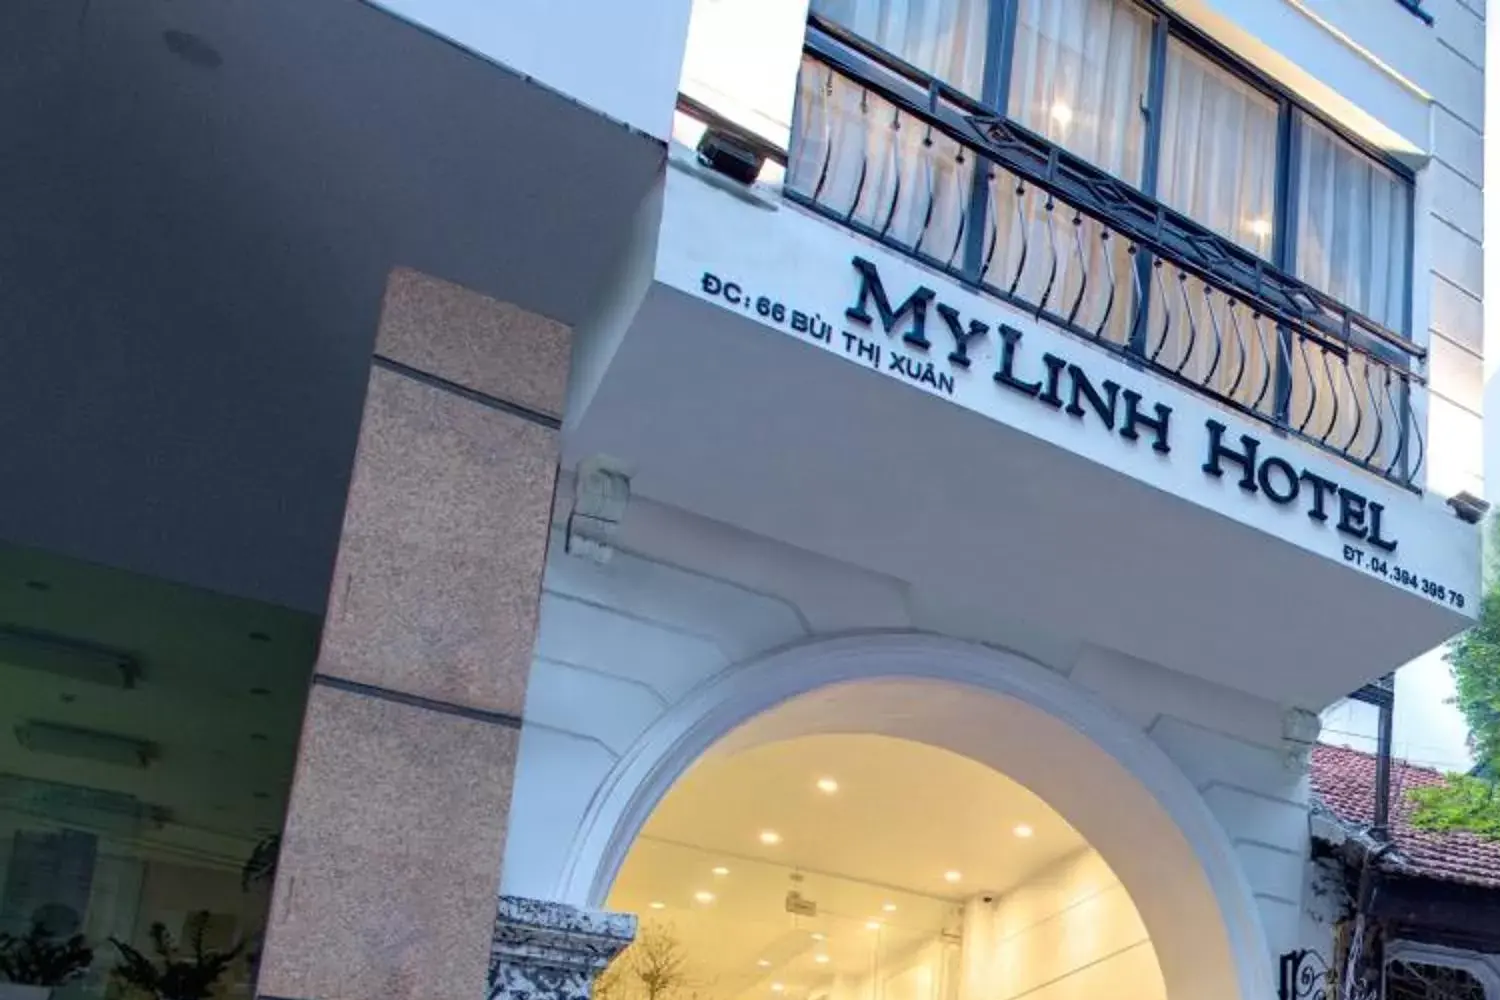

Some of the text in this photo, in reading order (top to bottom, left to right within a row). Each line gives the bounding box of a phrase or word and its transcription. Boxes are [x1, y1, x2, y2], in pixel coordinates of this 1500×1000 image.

[755, 296, 787, 324] 66
[791, 310, 833, 344] BÙI
[842, 331, 882, 369] THỊ
[889, 351, 955, 394] XUÂN
[1201, 419, 1398, 551] HOTEL
